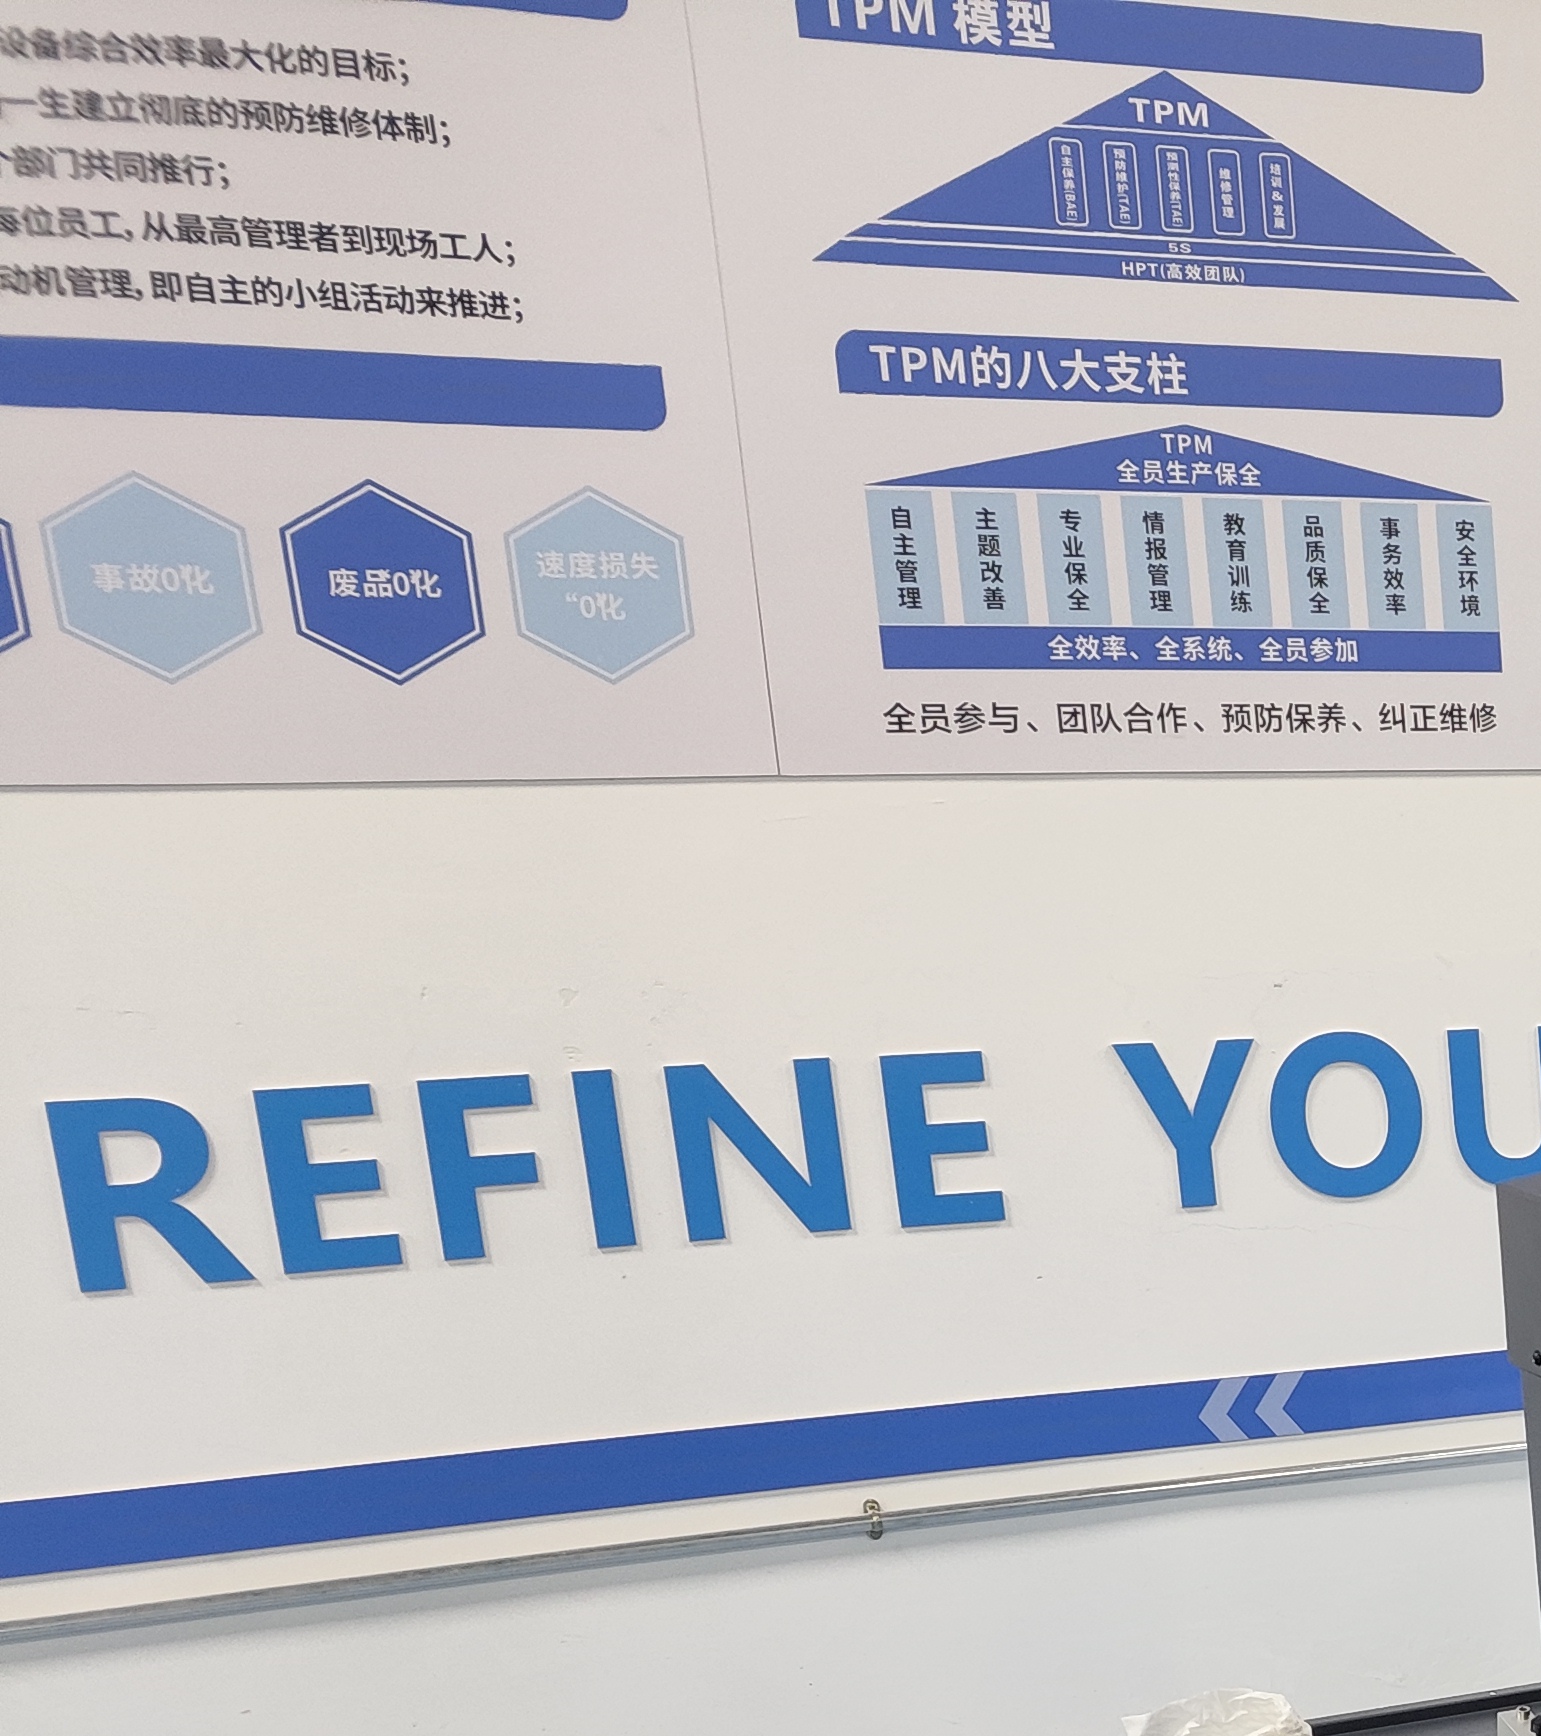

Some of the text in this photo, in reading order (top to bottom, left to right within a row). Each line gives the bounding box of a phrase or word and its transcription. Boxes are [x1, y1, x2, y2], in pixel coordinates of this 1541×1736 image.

[953, 0, 1055, 49] 模型
[1128, 97, 1210, 128] TPM
[0, 145, 231, 190] 部门共同推行；
[1121, 261, 1246, 283] HPT(高效团队)
[1168, 243, 1192, 253] 5S
[869, 345, 1188, 396] TPM的八大支柱
[1161, 433, 1213, 455] TPM
[1117, 460, 1262, 488] 全员生产保全
[536, 551, 659, 580] 速度损失
[890, 507, 922, 610] 自主管理
[975, 508, 1006, 612] 主题改善
[1059, 508, 1090, 612] 专业保全
[1142, 510, 1173, 613] 情报管理
[1223, 512, 1253, 614] 教育训练
[1303, 515, 1330, 615] 品质保全
[1380, 517, 1407, 616] 事务效率
[1455, 519, 1481, 617] 安全环境
[1047, 635, 1359, 665] 全效率、全系统、全员参加
[882, 702, 1498, 737] 全员参与、团队合作、预防保养、纠正维修
[45, 1050, 1008, 1294] REFINE
